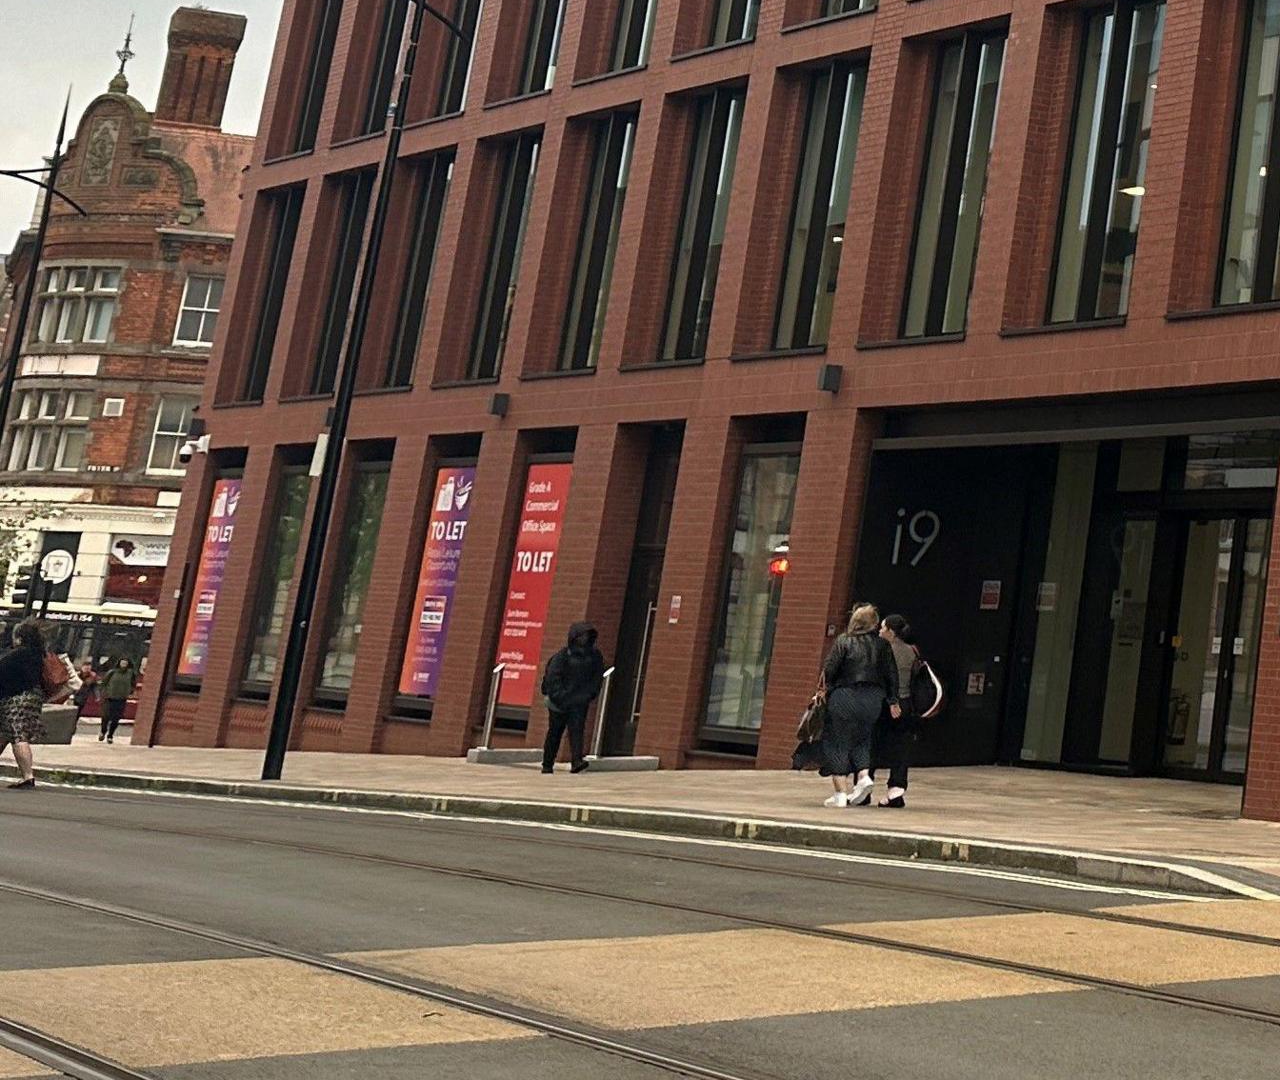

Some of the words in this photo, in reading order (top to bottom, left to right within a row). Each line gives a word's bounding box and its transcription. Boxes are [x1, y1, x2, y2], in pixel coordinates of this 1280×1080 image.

[525, 500, 560, 512] Commercial
[207, 525, 218, 542] TO
[218, 525, 235, 542] LET
[431, 521, 445, 540] TO
[445, 521, 468, 540] LET
[521, 520, 538, 532] Office
[538, 521, 557, 534] Space
[891, 507, 940, 567] i9
[516, 551, 532, 572] TO
[532, 551, 554, 572] LET
